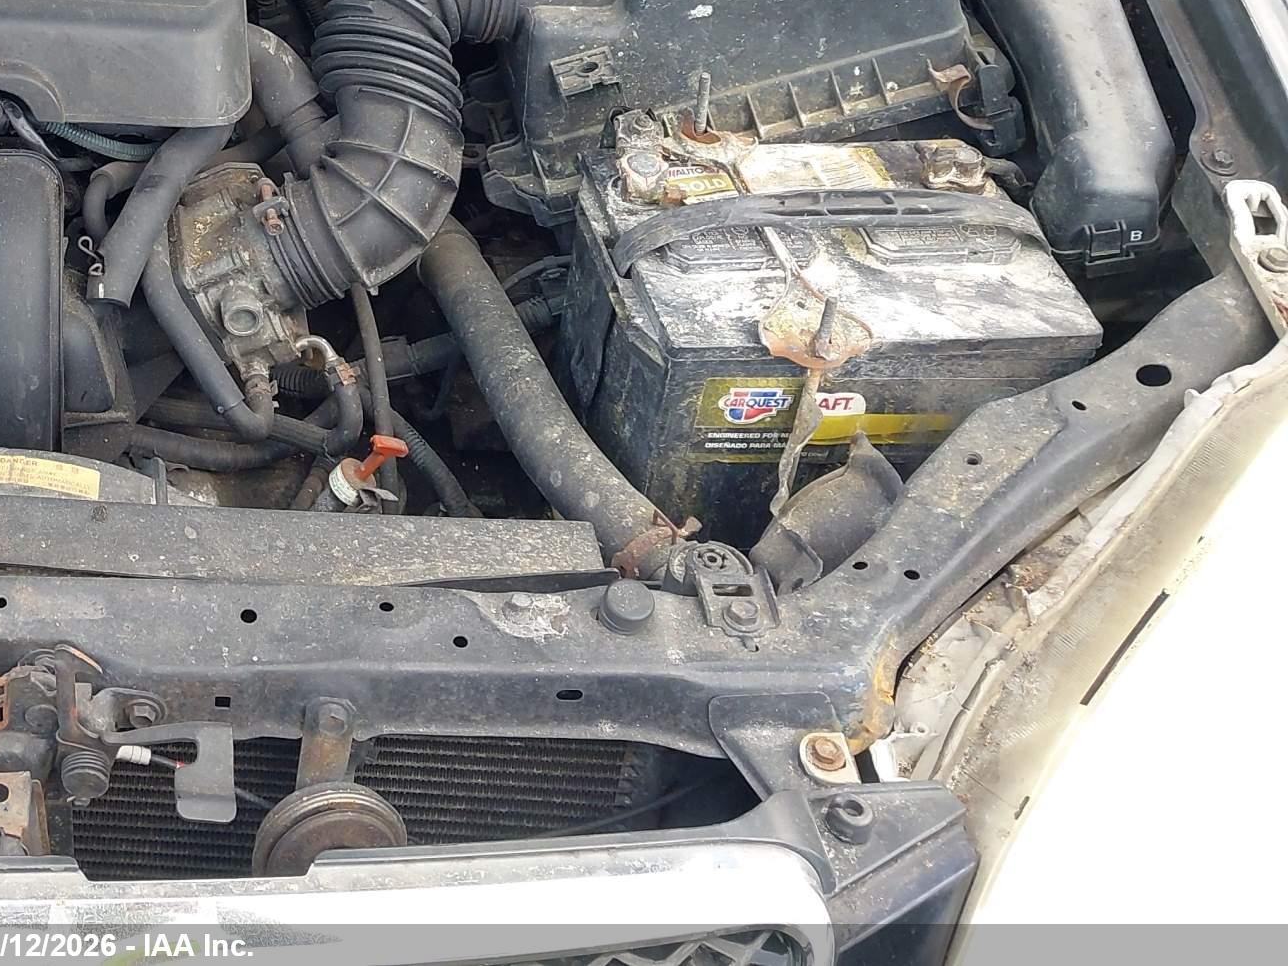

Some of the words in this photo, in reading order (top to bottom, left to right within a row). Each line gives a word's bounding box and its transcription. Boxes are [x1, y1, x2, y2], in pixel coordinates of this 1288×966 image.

[1130, 230, 1143, 241] B
[723, 397, 789, 409] CARQUEST
[704, 441, 747, 449] DISEÑADO
[0, 457, 38, 466] DANGER
